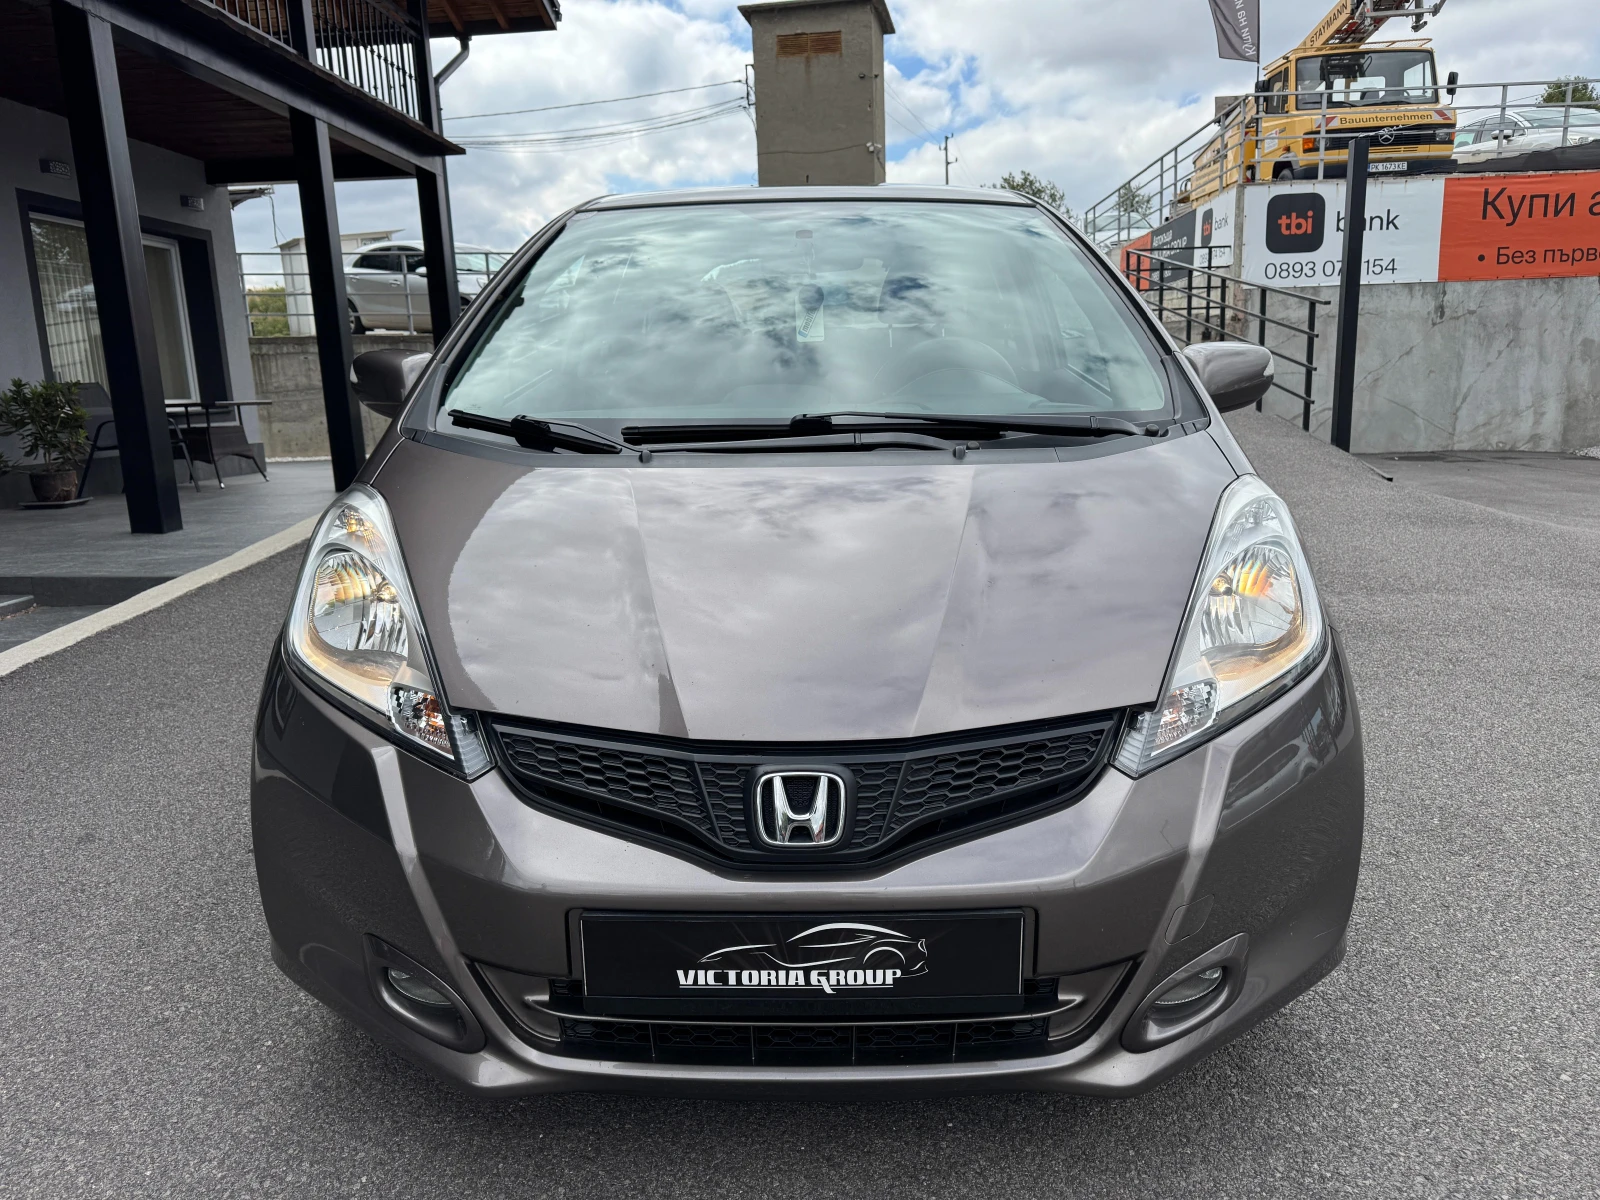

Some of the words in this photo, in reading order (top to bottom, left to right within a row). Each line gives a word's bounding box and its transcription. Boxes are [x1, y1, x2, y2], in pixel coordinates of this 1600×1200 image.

[1310, 0, 1348, 47] STAYMANN
[1340, 113, 1432, 125] Bauunternehmen
[1482, 187, 1576, 227] Купи
[1214, 212, 1228, 231] bank
[1278, 210, 1313, 235] tbi
[1336, 208, 1400, 232] bnk
[1496, 246, 1536, 265] Без
[1543, 247, 1600, 266] първ
[1265, 260, 1316, 279] 0893
[1363, 258, 1398, 275] 154
[676, 969, 806, 985] VICTORIA
[811, 969, 902, 994] GROUP
